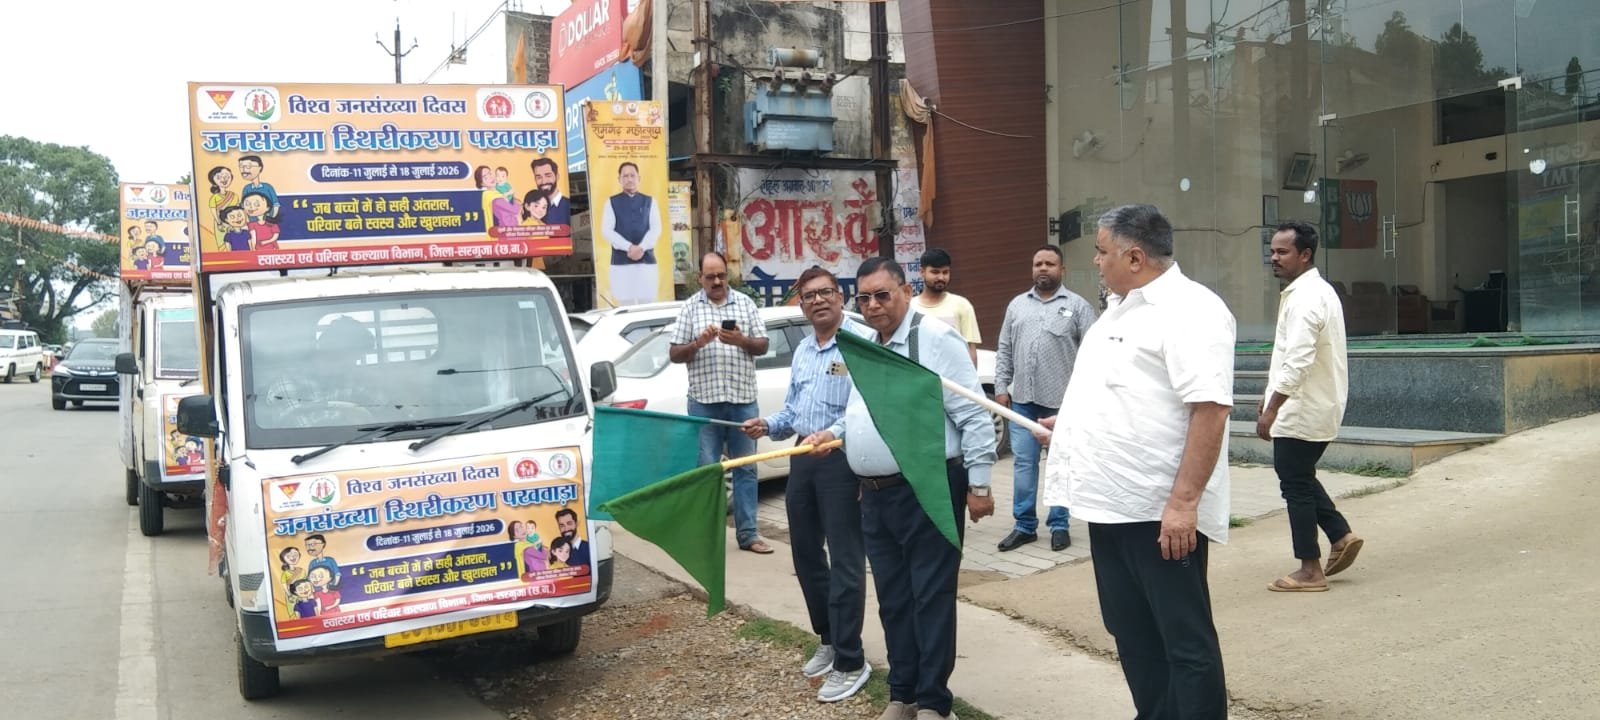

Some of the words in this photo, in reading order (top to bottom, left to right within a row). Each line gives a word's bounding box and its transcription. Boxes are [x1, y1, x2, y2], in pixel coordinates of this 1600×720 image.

[567, 0, 610, 47] DOLLAR
[288, 95, 330, 113] विश्व
[336, 95, 416, 114] जनसंख्या
[423, 95, 466, 114] दिवस
[202, 125, 324, 151] जनसंख्या
[332, 124, 460, 150] स्थिरीकरण
[467, 129, 558, 153] पखवाड़ा
[364, 164, 387, 179] जुलाई
[389, 163, 398, 176] से
[412, 163, 435, 178] जुलाई
[438, 166, 460, 176] 2026
[127, 204, 188, 219] जनसंख्य
[312, 201, 331, 215] जब
[334, 198, 360, 213] बच्चों
[375, 197, 387, 212] हो
[389, 196, 410, 212] सही
[413, 198, 454, 213] अंतराल,
[306, 216, 342, 232] परिवार
[345, 214, 363, 231] बने
[397, 212, 417, 229] और
[420, 214, 461, 231] खुशहाल
[298, 250, 313, 264] एवं
[316, 249, 348, 262] परिवार
[350, 249, 390, 261] कल्याण
[347, 479, 382, 495] विश्व
[388, 471, 457, 489] जनसंख्या
[462, 465, 499, 481] दिवस
[274, 507, 378, 535] जनसंख्या
[385, 492, 496, 521] स्थिरीकरण
[501, 484, 577, 506] पखवाड़ा
[412, 528, 433, 544] जुलाई
[434, 529, 442, 539] से
[454, 524, 475, 538] जुलाई
[476, 523, 496, 534] 2026
[368, 567, 385, 579] जब
[435, 554, 453, 569] सही
[364, 579, 395, 594] परिवार
[442, 567, 460, 583] और
